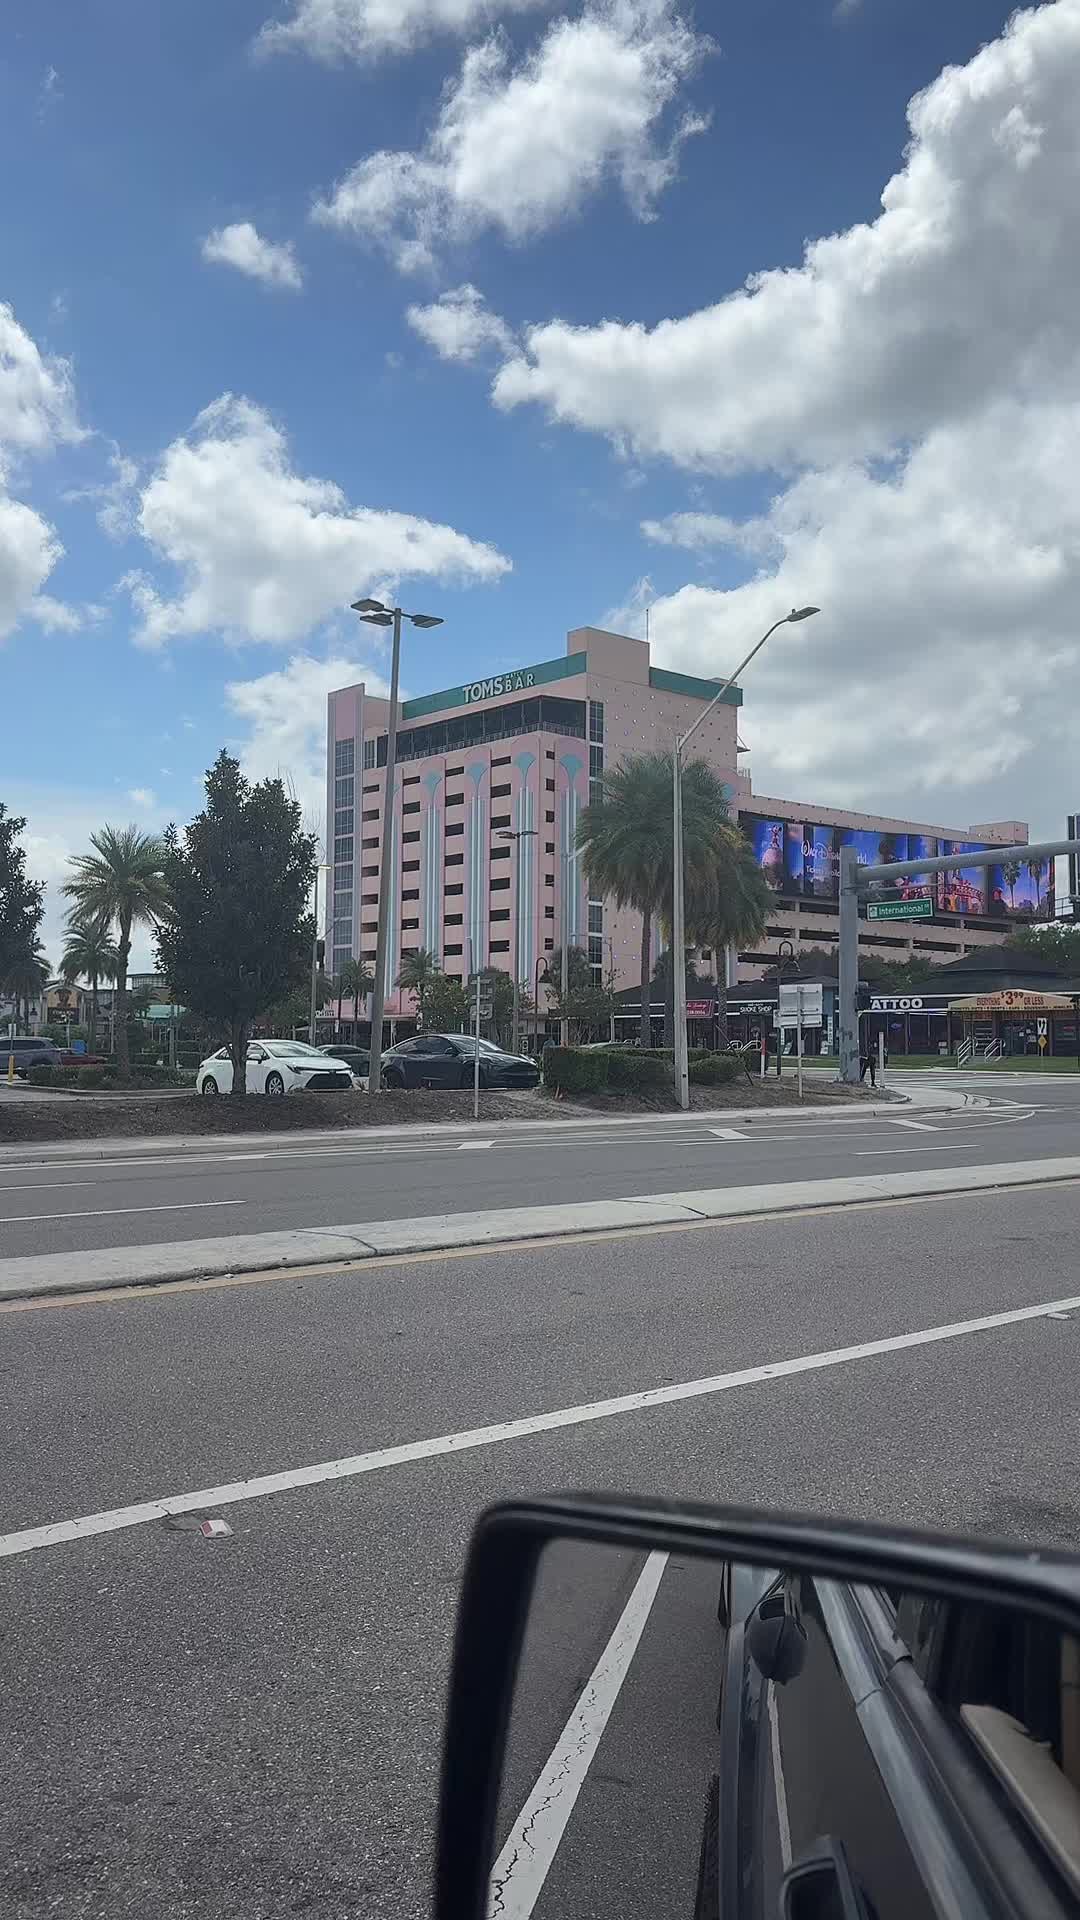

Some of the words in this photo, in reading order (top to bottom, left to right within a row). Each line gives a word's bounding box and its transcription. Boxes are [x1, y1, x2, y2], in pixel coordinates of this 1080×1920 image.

[463, 677, 503, 703] TOMS
[505, 673, 534, 692] BAR
[879, 904, 923, 915] International
[870, 998, 923, 1010] ATTOO
[1024, 997, 1031, 1005] OR
[1032, 997, 1044, 1005] LESS
